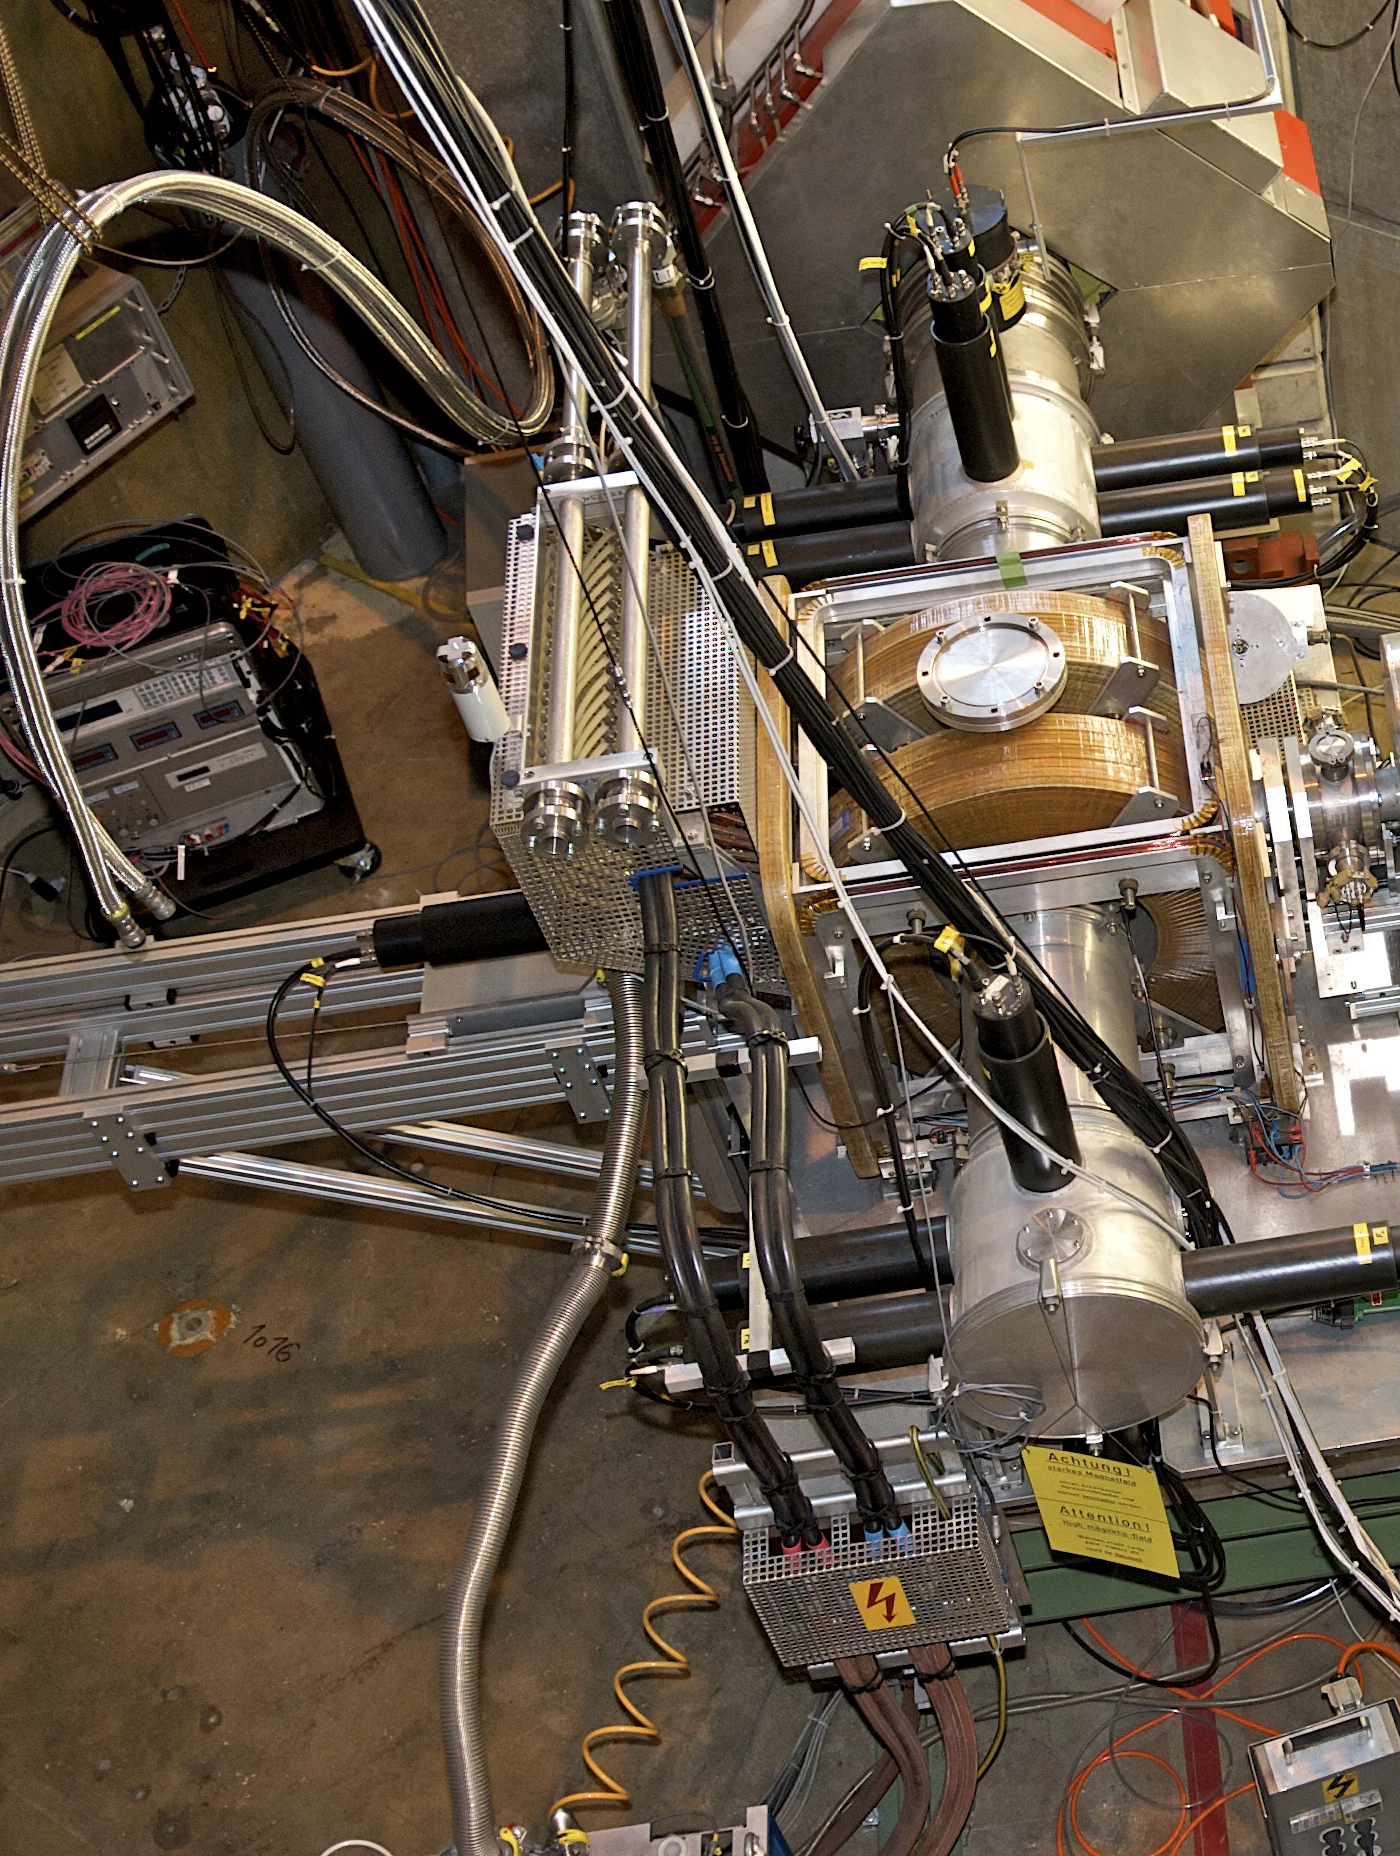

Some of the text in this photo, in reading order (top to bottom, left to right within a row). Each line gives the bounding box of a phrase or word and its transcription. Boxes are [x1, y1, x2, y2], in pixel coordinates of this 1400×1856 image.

[243, 1324, 300, 1362] 1076
[1048, 1452, 1131, 1477] Achtung!
[1060, 1506, 1150, 1533] Attention!
